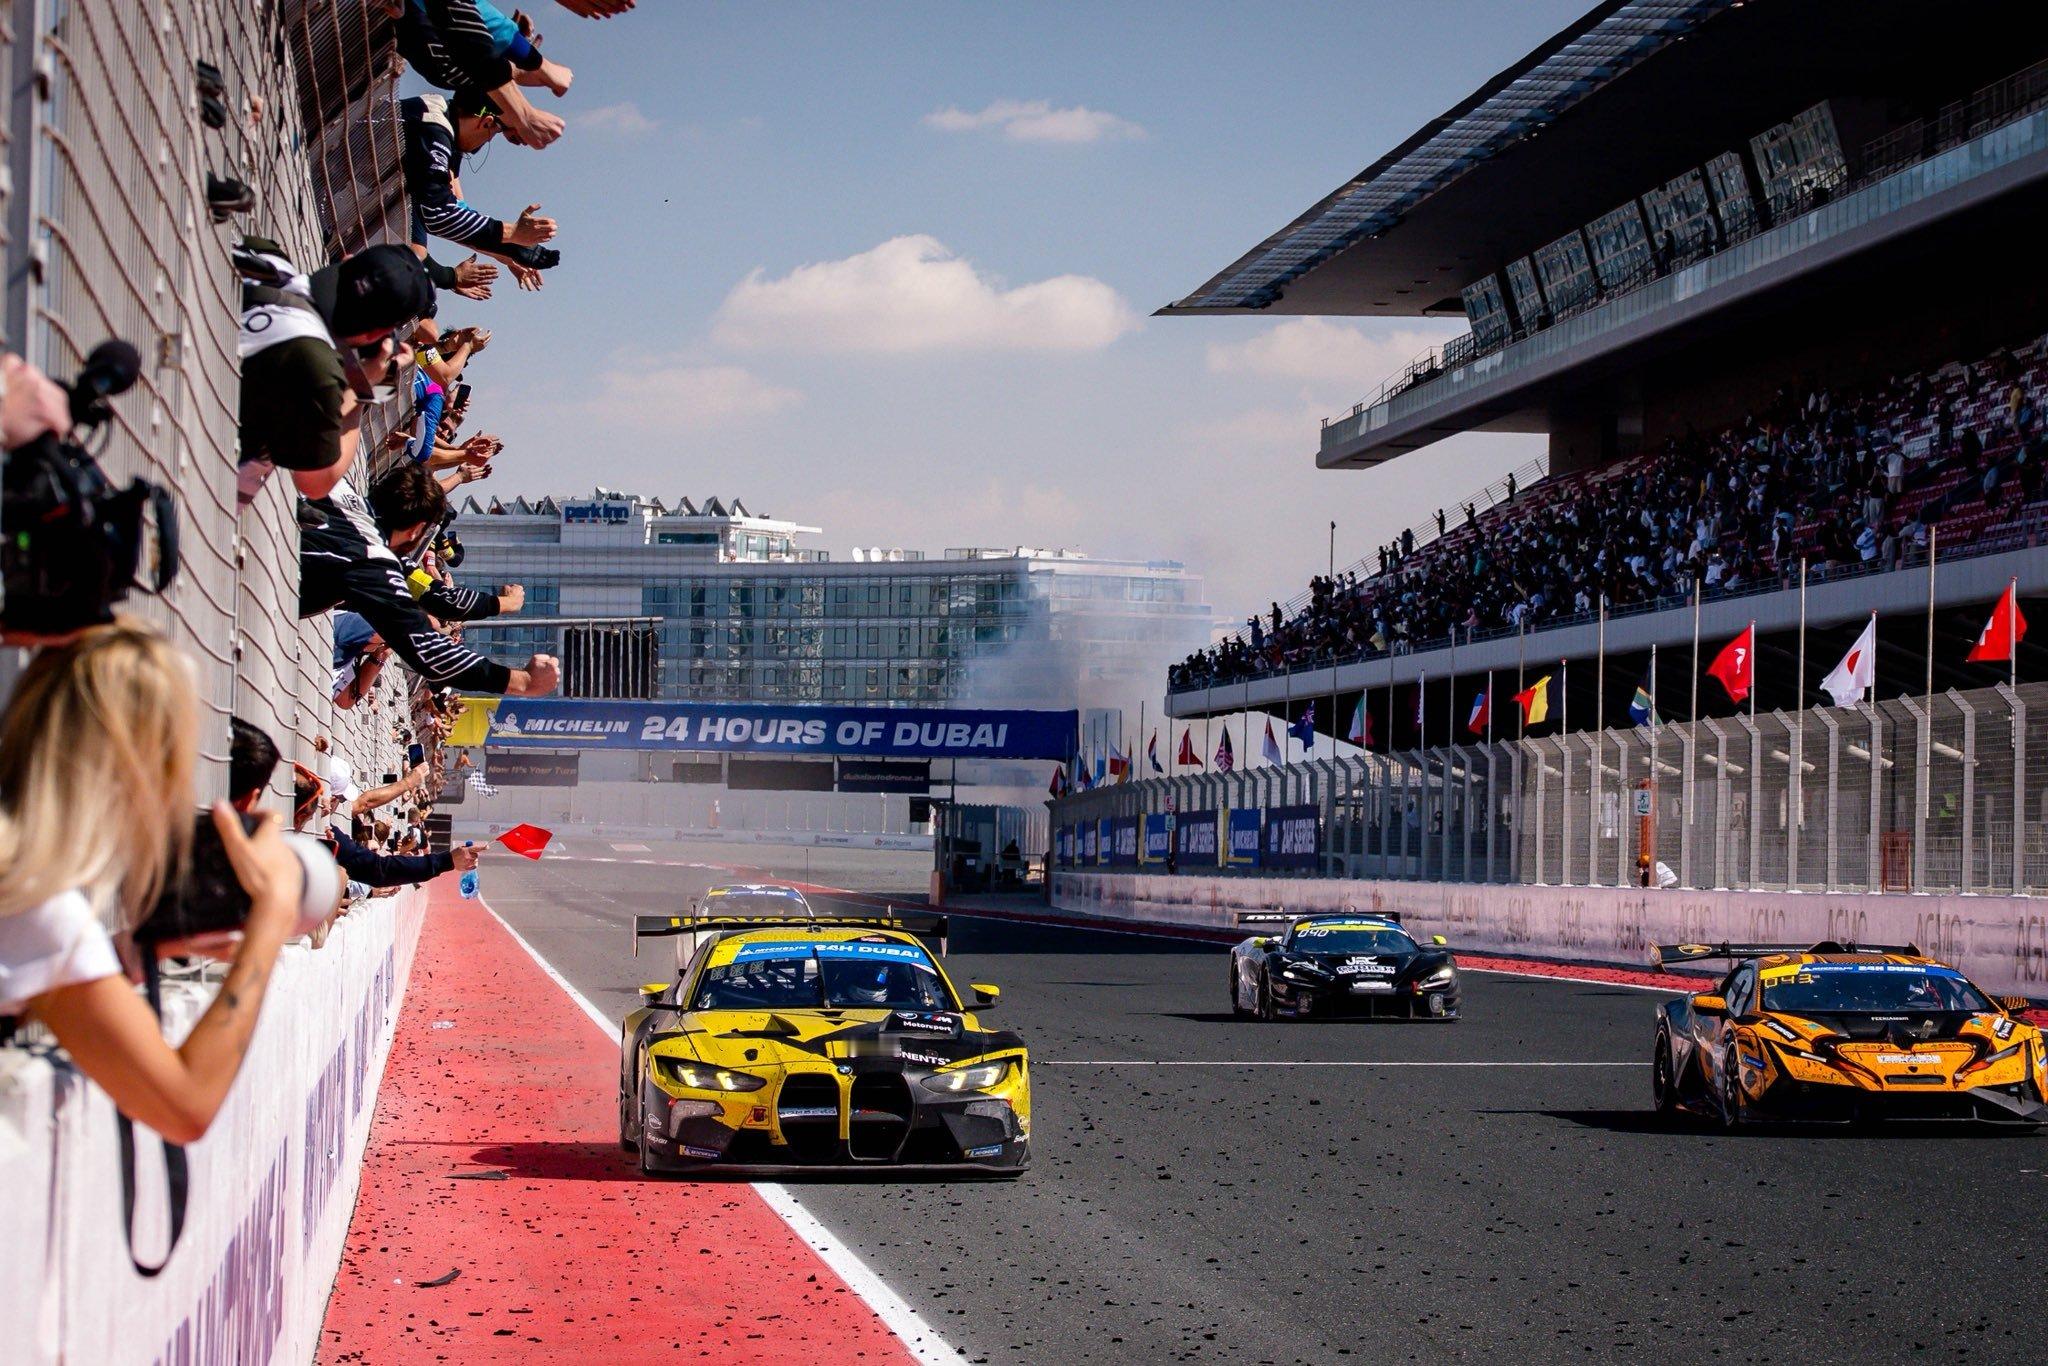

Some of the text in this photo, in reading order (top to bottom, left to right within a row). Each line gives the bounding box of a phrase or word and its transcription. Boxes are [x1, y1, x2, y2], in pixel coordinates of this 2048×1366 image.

[524, 718, 630, 733] MICHELIN
[641, 716, 1008, 748] 24 HOURS OF DUBAI
[1298, 928, 1330, 938] 040
[814, 944, 920, 959] 24H DUBAI
[1764, 973, 1812, 989] 043
[903, 1020, 952, 1034] Motorsport
